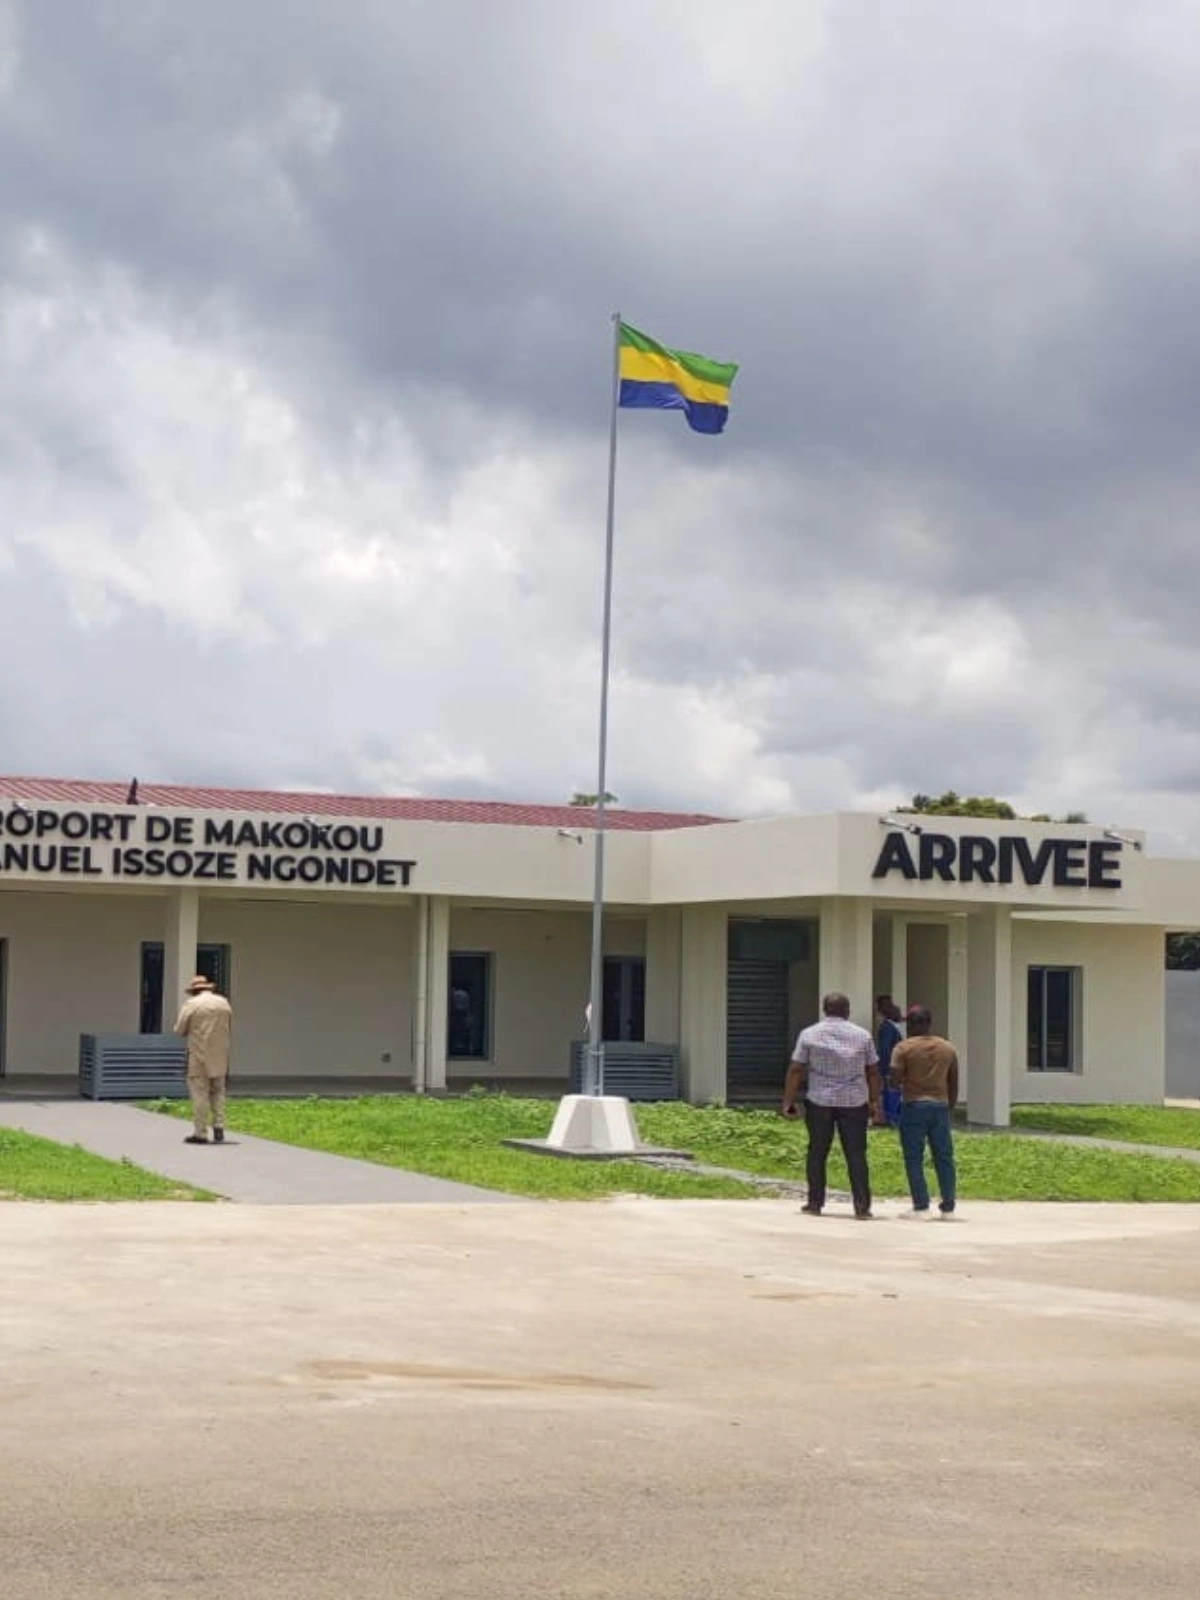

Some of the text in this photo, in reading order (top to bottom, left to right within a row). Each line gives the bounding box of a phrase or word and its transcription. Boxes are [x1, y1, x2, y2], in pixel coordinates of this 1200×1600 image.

[144, 816, 195, 844] DE
[204, 819, 384, 853] MAKOKOU
[112, 848, 238, 880] ISSOZE
[247, 854, 416, 885] NGONDET
[872, 832, 1122, 889] ARRIVEE
